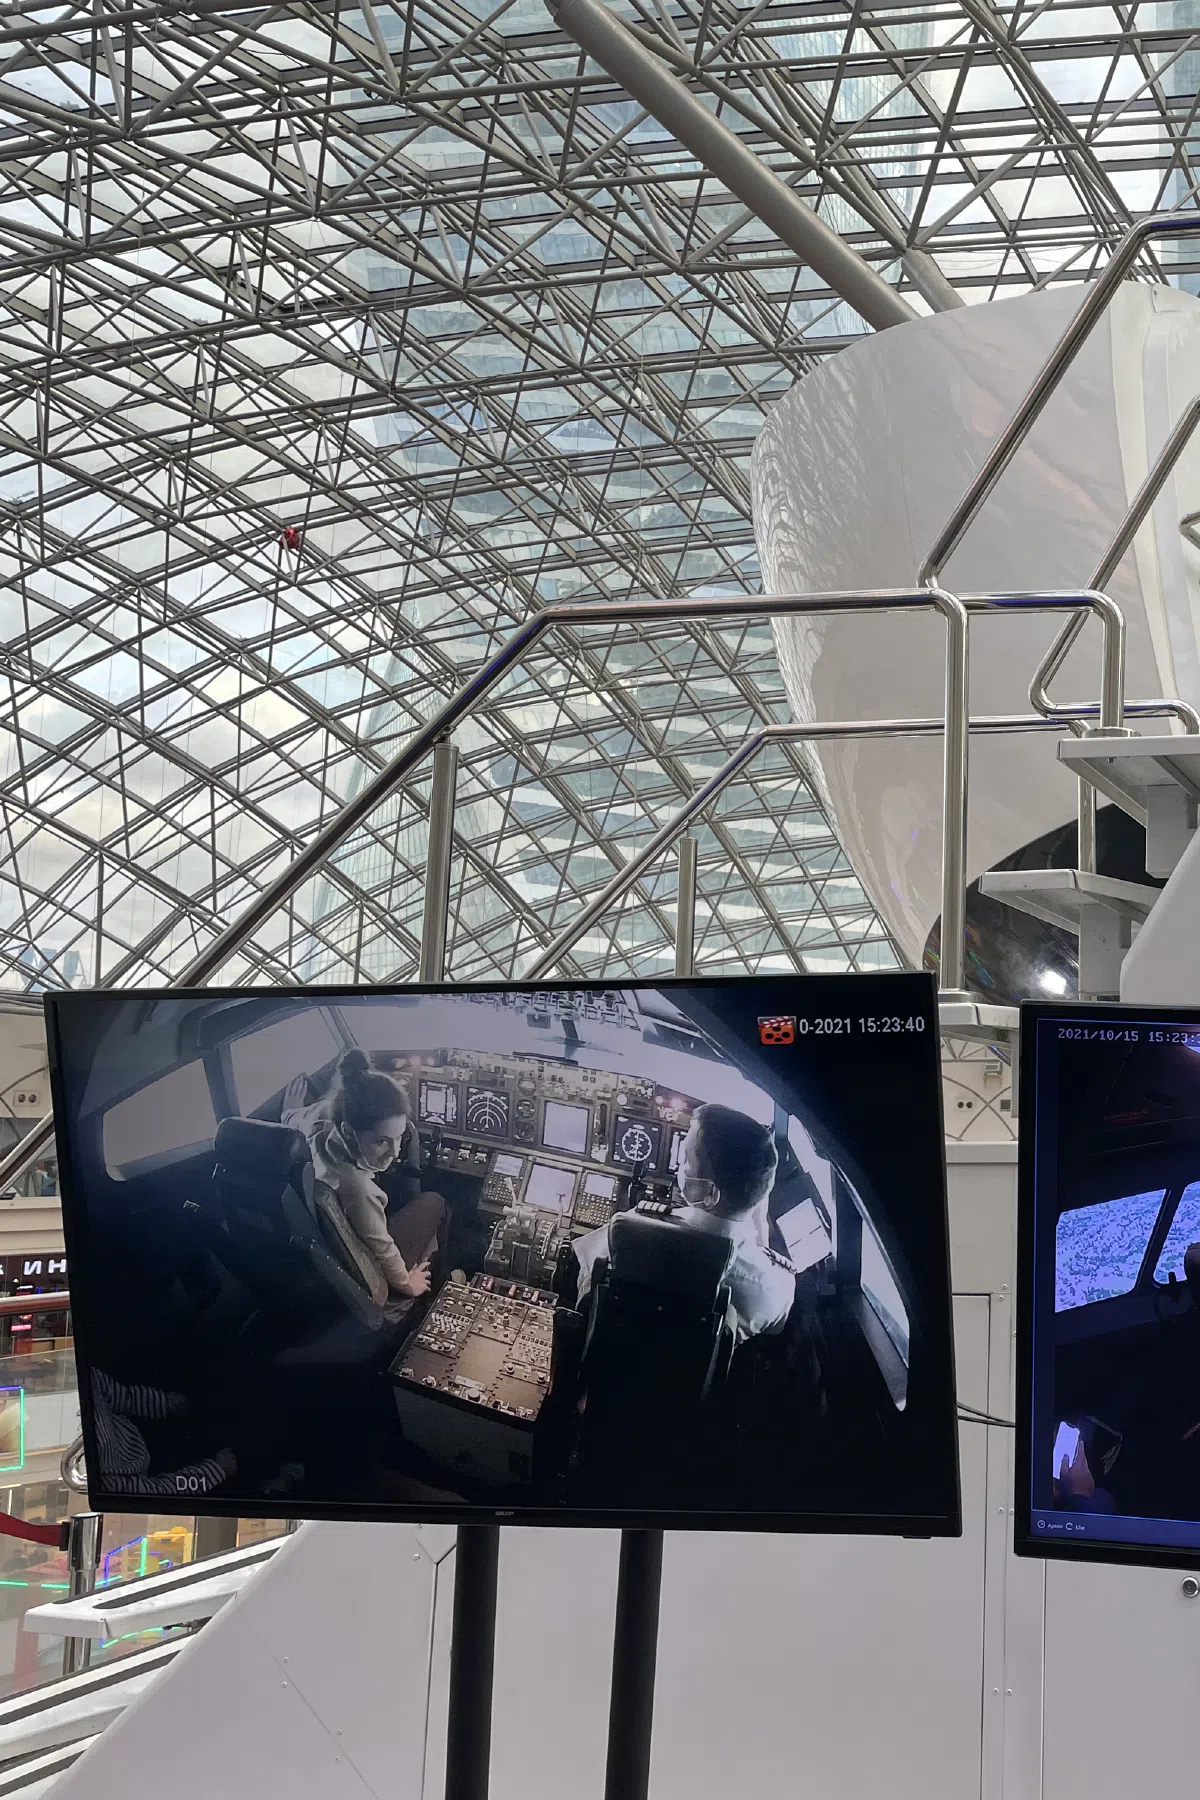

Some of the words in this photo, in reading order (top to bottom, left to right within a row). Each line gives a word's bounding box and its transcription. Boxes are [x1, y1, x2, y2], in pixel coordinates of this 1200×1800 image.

[858, 1016, 925, 1033] 15:23:40
[1057, 1028, 1139, 1042] 2021/10/15
[175, 1475, 207, 1492] D01
